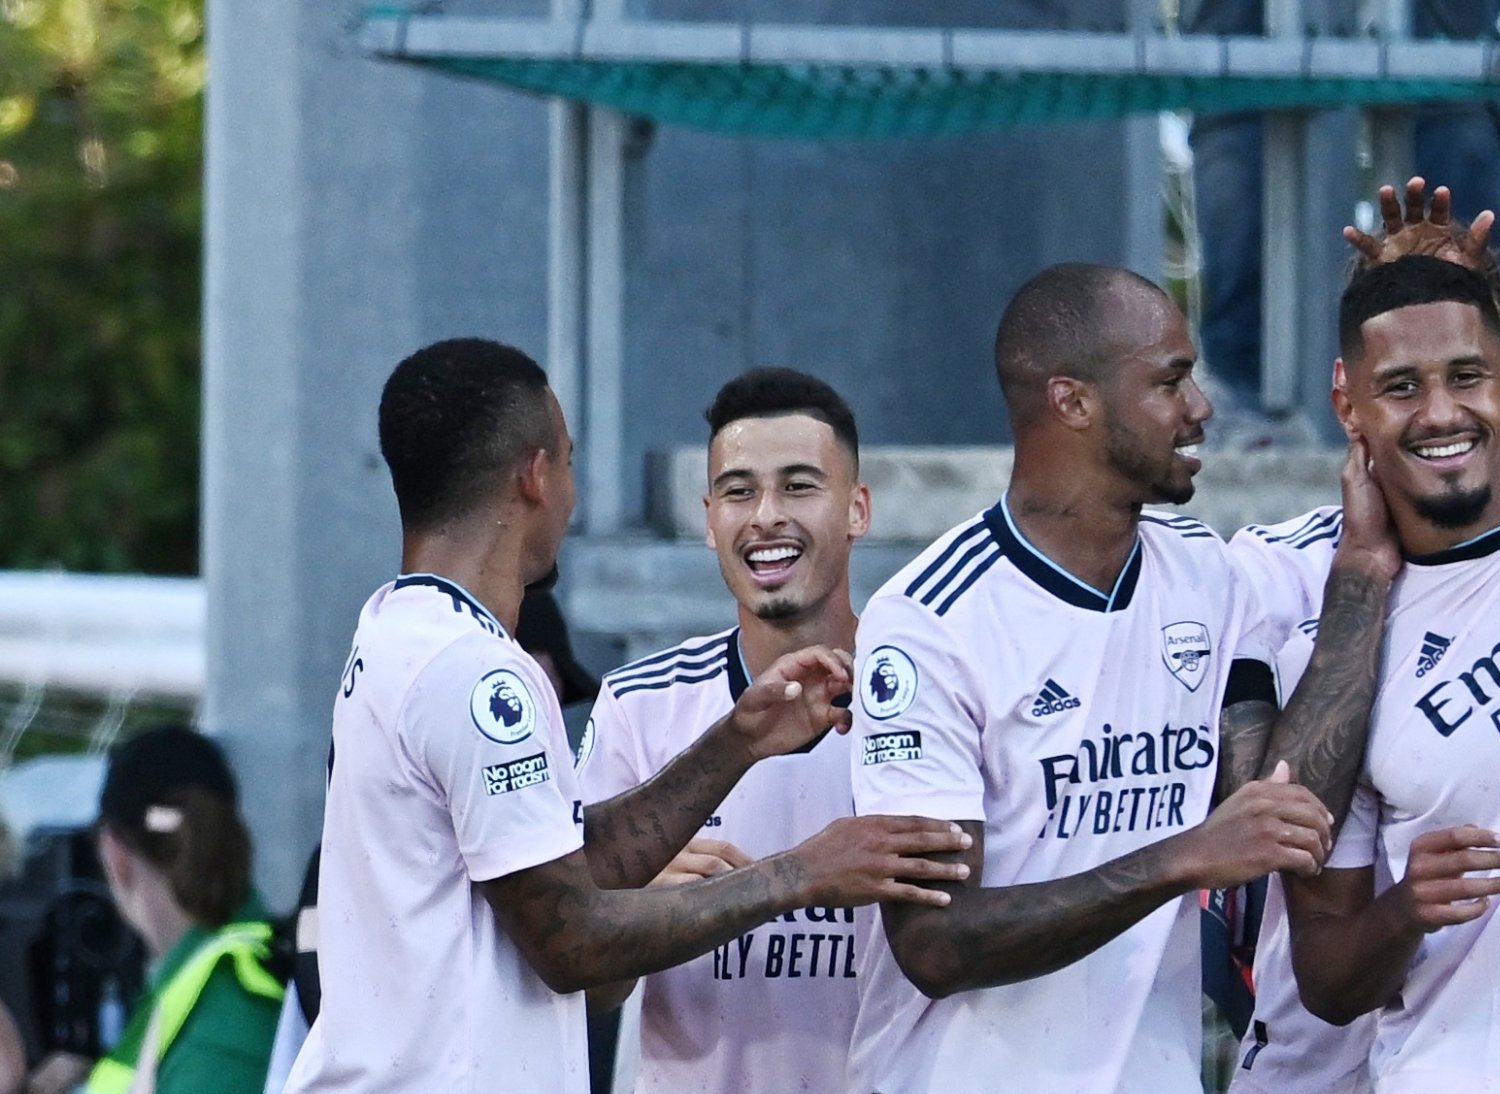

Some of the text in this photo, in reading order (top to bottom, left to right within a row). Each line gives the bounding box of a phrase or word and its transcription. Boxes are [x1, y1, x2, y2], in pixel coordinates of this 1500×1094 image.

[1167, 635, 1206, 646] Arsenal
[1031, 697, 1081, 717] adidas
[863, 734, 914, 752] No room
[877, 746, 921, 763] racism
[482, 756, 545, 781] No room
[486, 769, 550, 795] for racism
